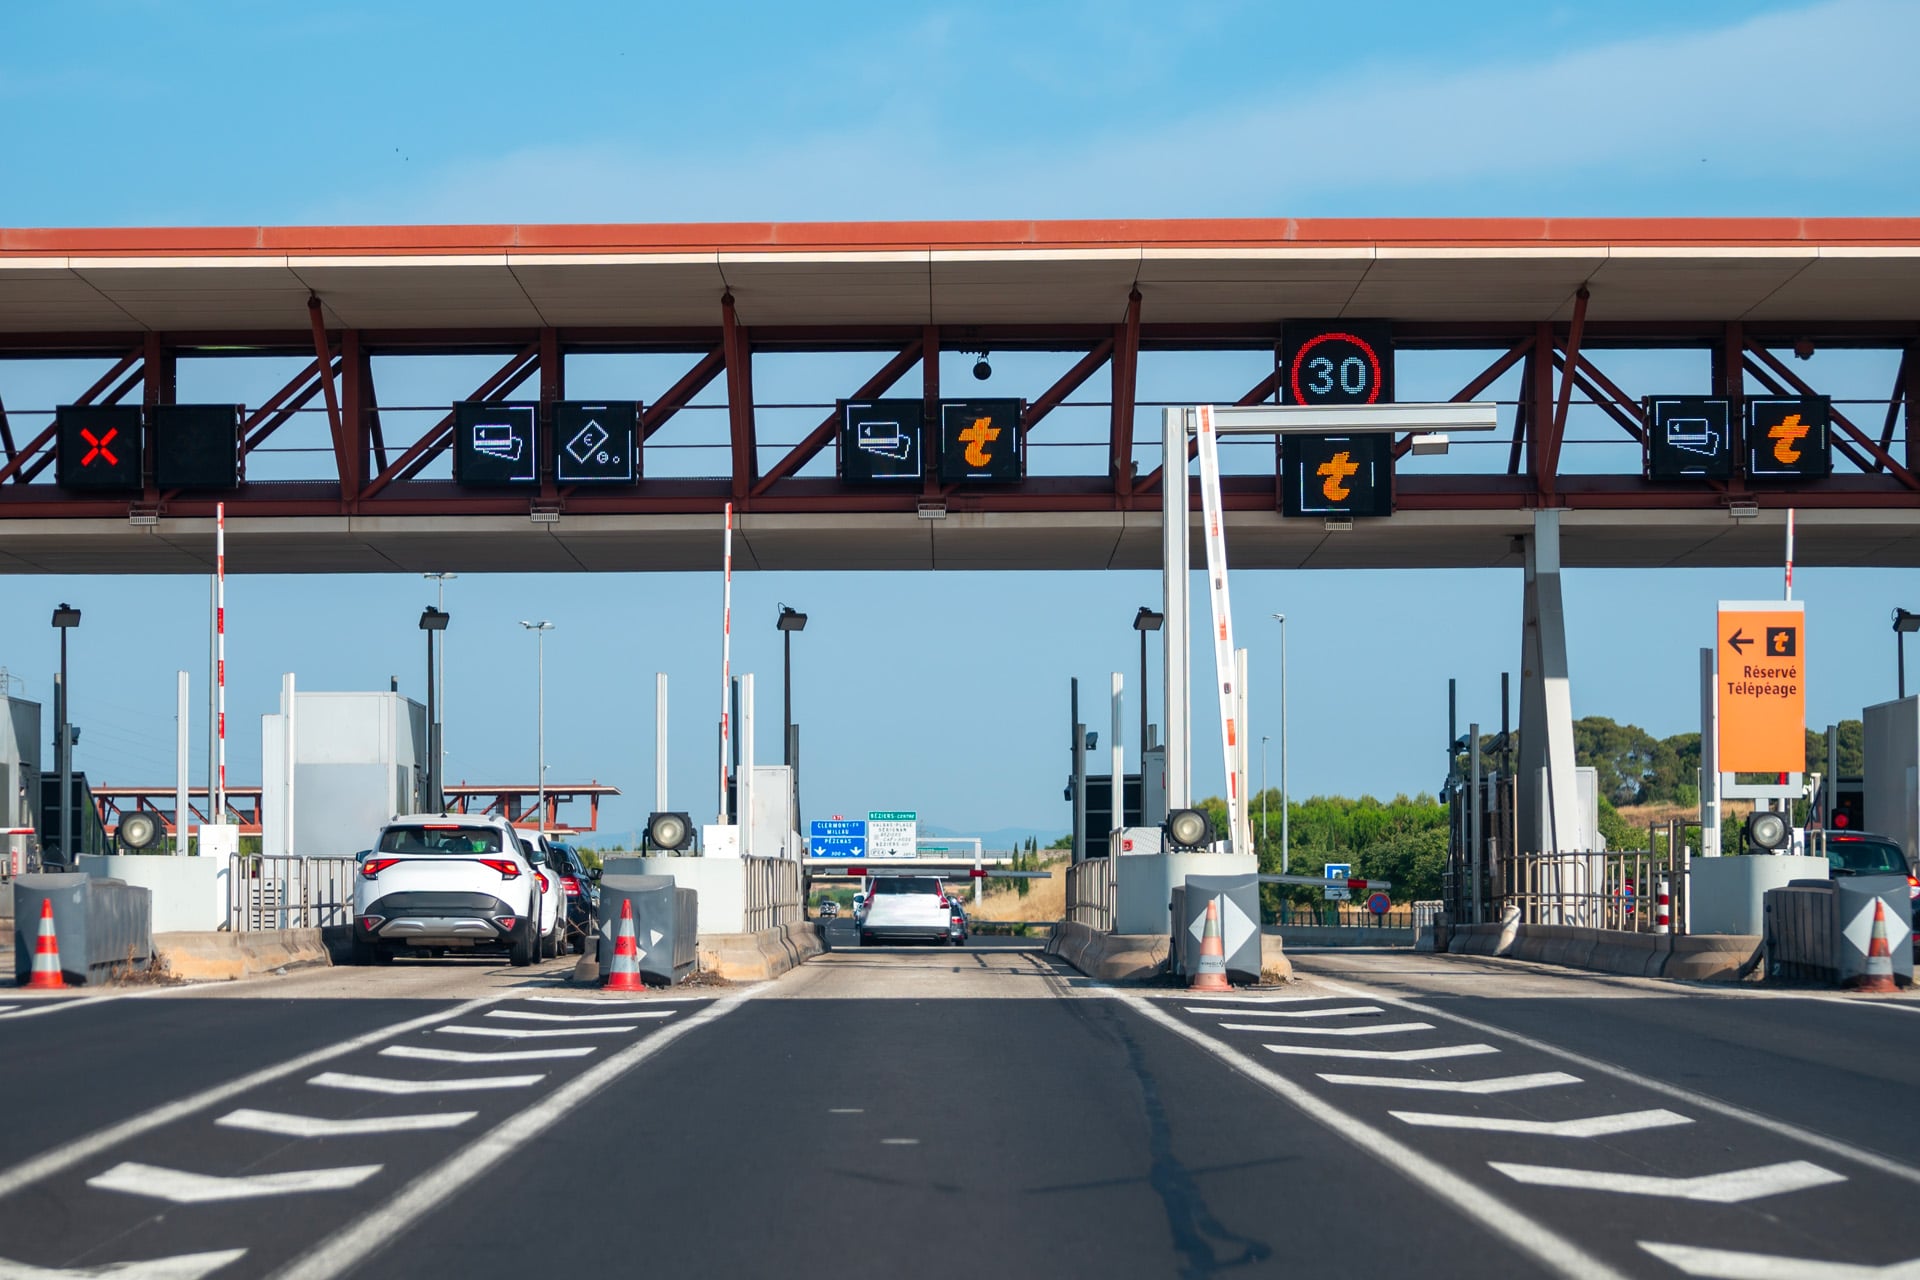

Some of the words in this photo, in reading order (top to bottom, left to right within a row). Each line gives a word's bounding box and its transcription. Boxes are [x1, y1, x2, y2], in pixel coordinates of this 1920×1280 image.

[1308, 356, 1366, 395] 30
[1744, 665, 1797, 678] Réservé
[1727, 681, 1797, 698] Télépéage
